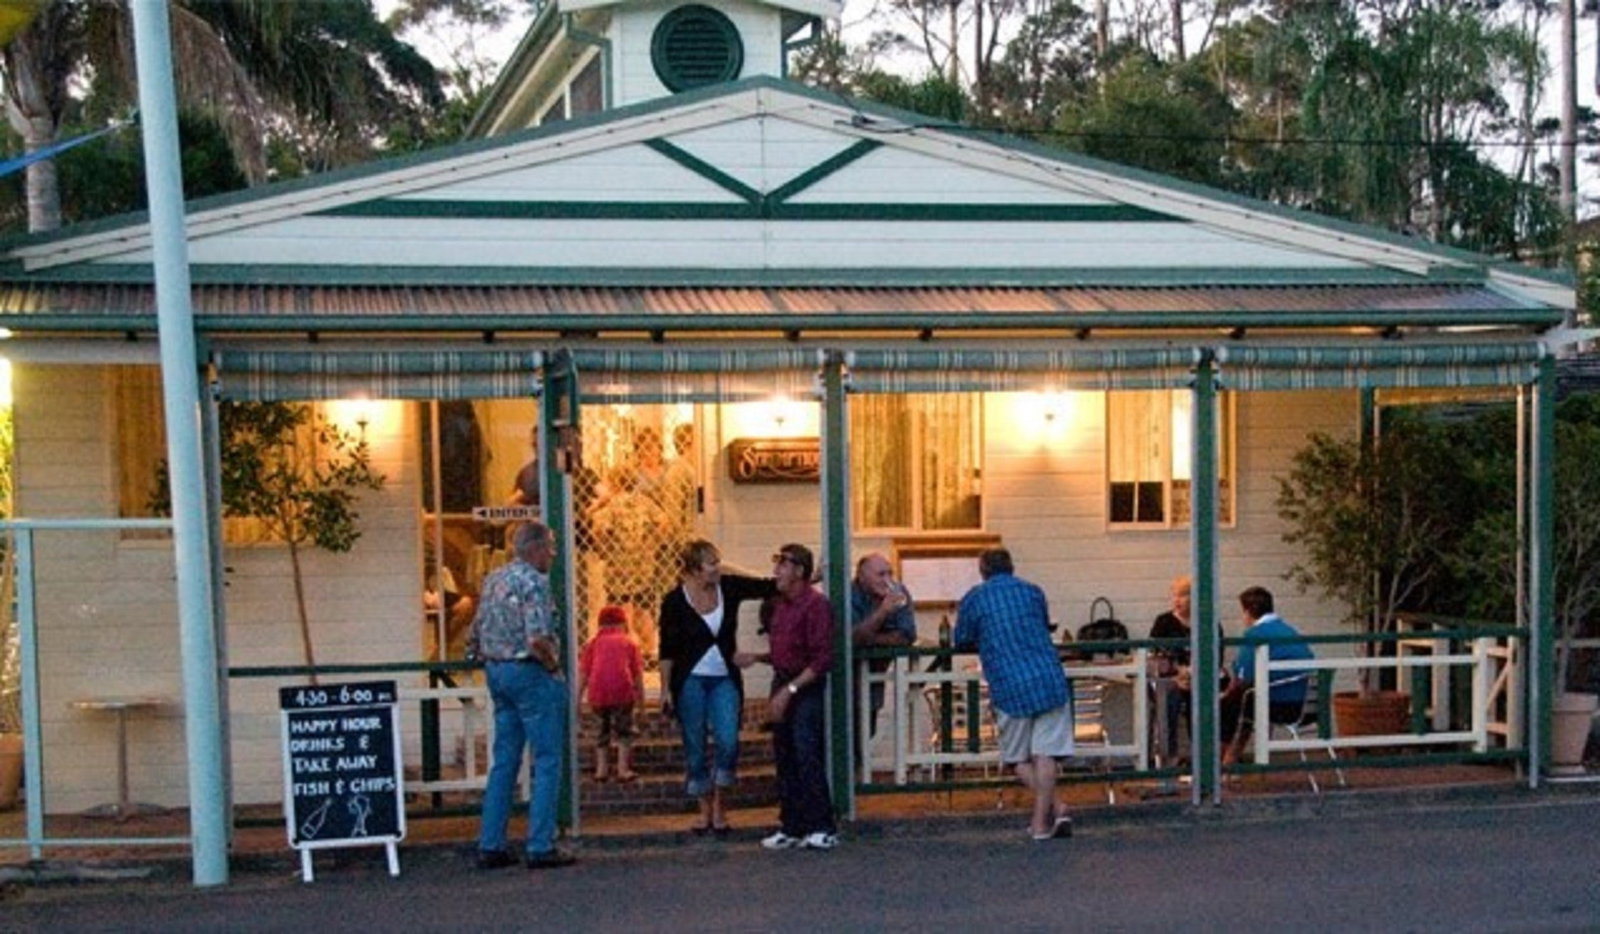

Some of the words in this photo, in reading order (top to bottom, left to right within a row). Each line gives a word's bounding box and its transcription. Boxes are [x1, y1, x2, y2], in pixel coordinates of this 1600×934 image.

[291, 720, 337, 734] HAPPY
[341, 717, 382, 731] HOUR
[290, 737, 345, 752] DRINKS
[294, 757, 331, 773] TAKE
[335, 755, 378, 771] AWAY
[294, 781, 330, 796] FISH
[350, 777, 396, 794] CHIPS
